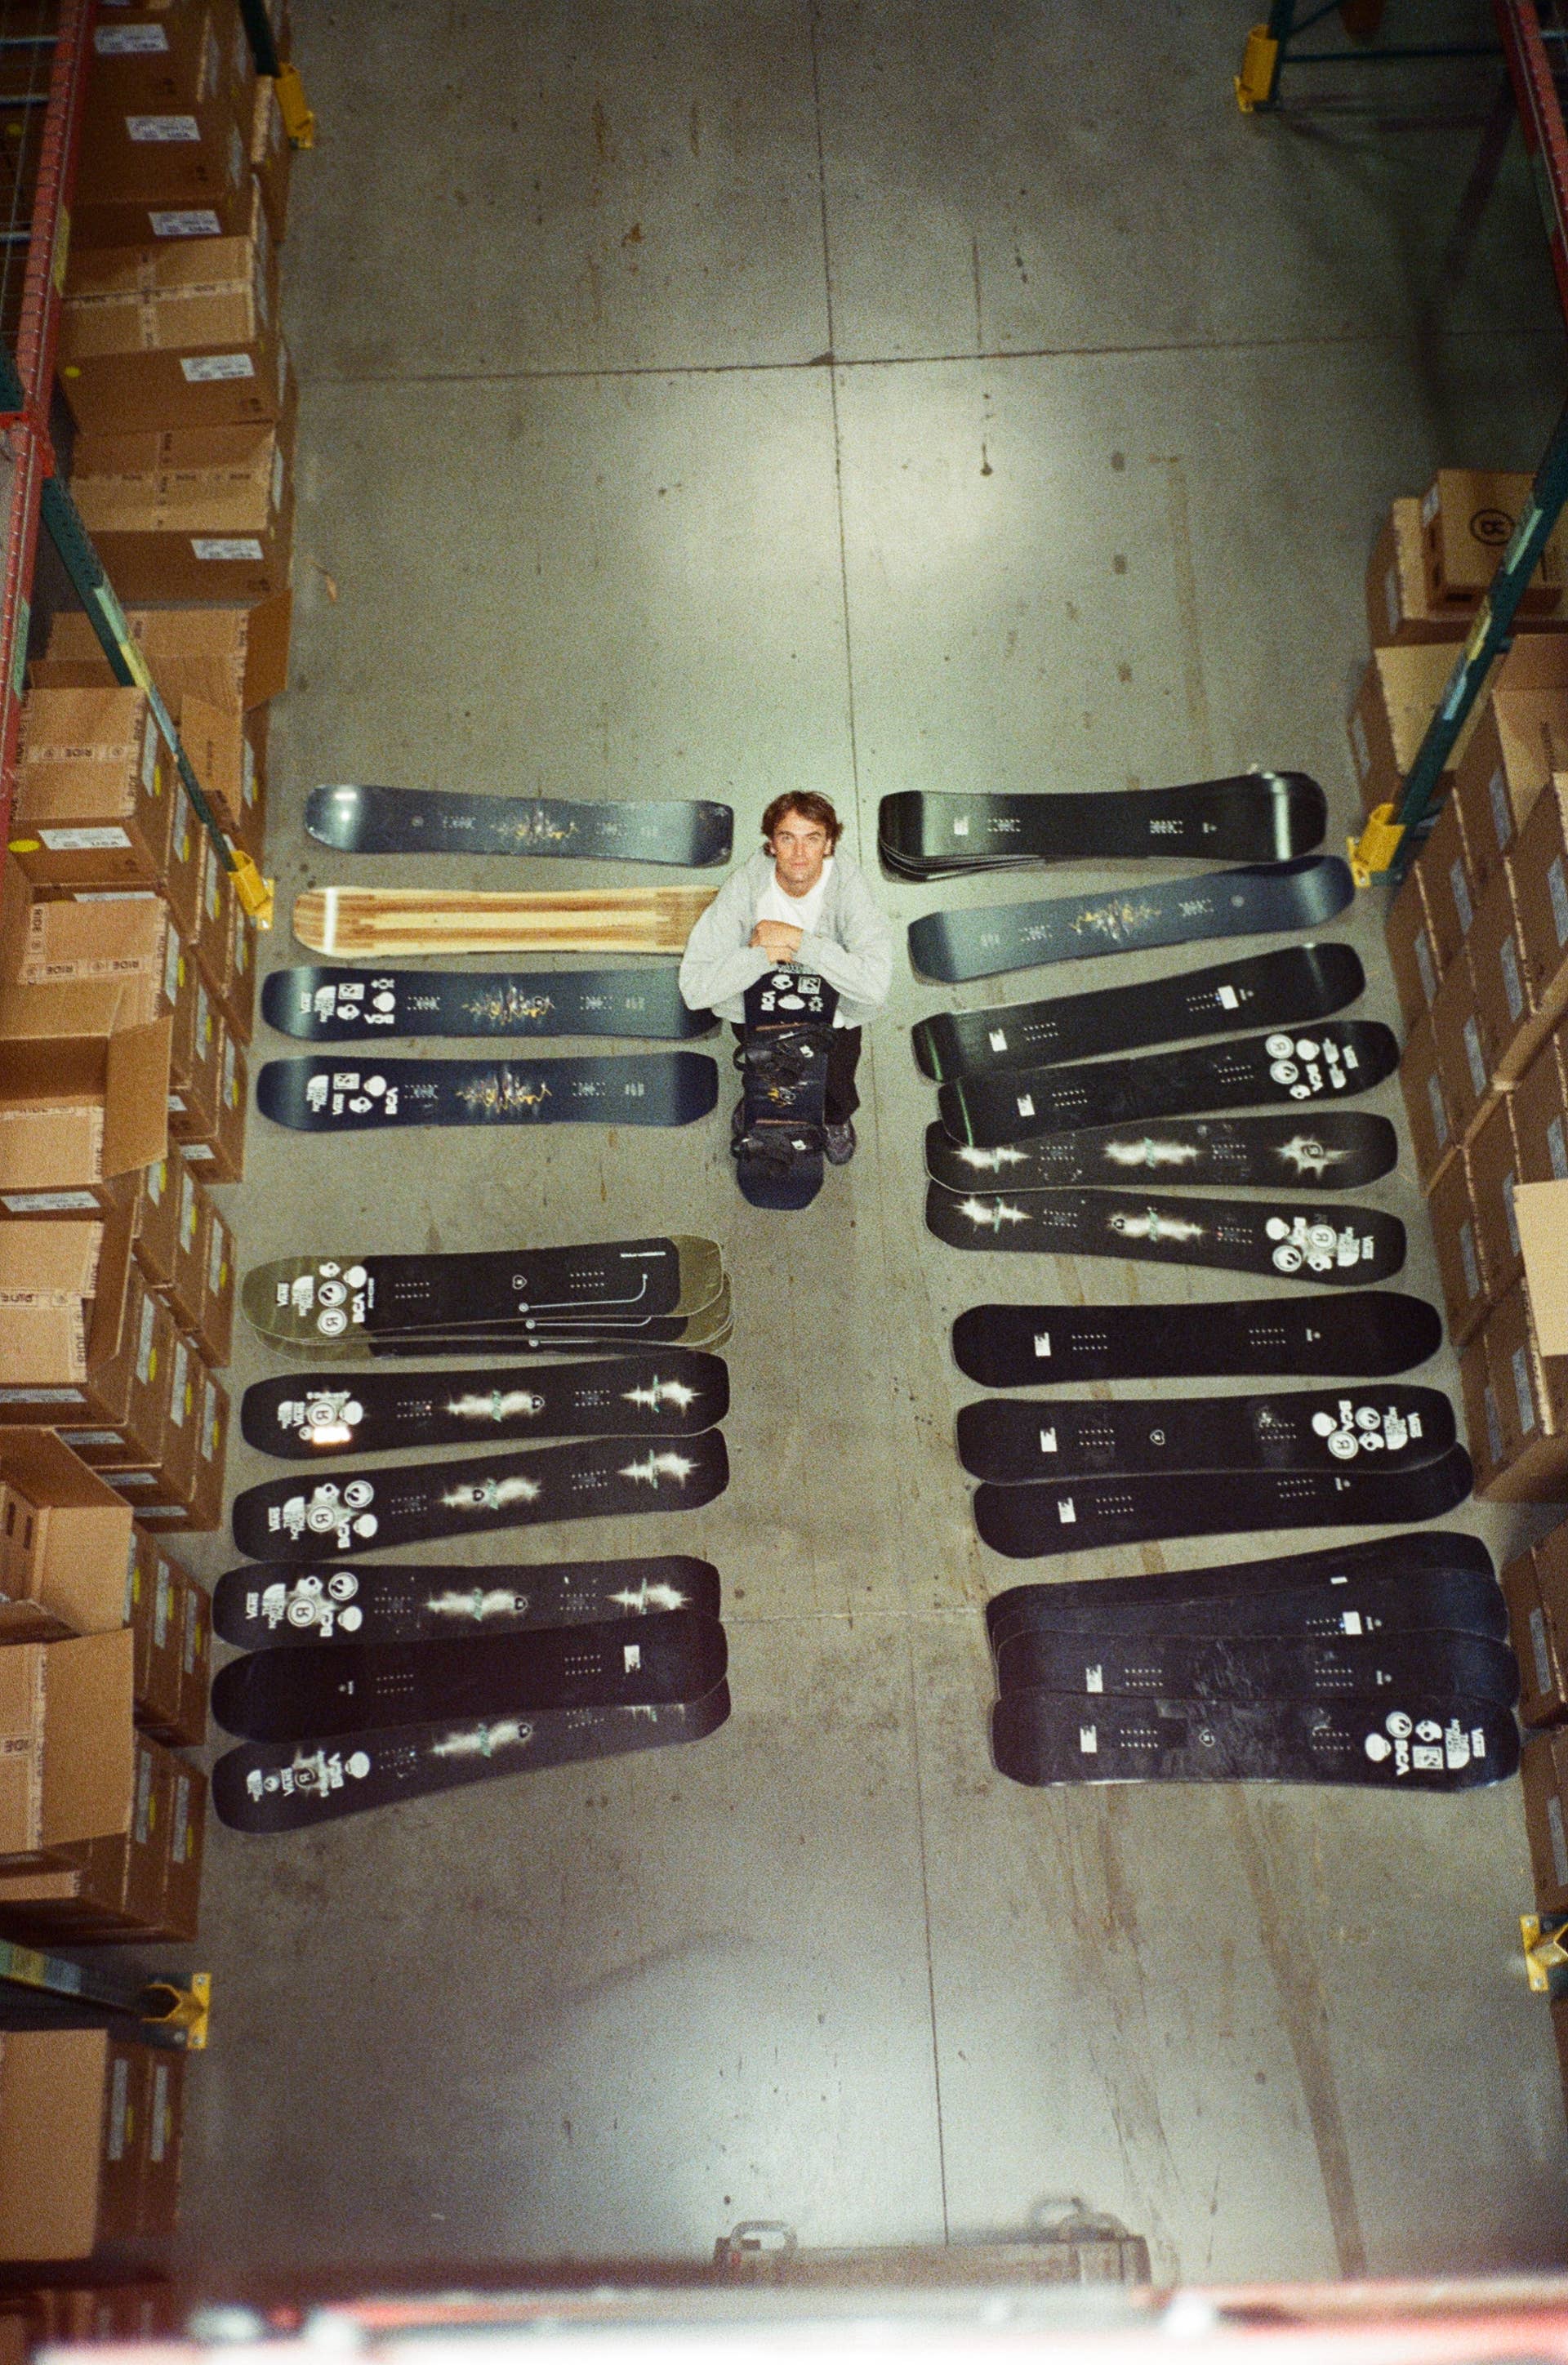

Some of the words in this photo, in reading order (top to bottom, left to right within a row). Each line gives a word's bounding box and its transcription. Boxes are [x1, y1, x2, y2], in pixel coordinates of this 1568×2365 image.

[46, 965, 74, 975] RIDE
[113, 960, 140, 971] RIDE
[1306, 1063, 1324, 1093] BCA
[385, 1087, 399, 1115] BCA
[351, 1292, 366, 1324] BCA
[1338, 1400, 1355, 1431] BCA
[337, 1517, 351, 1549] BCA
[328, 1753, 345, 1789] BCA
[1394, 1739, 1410, 1776] BCA
